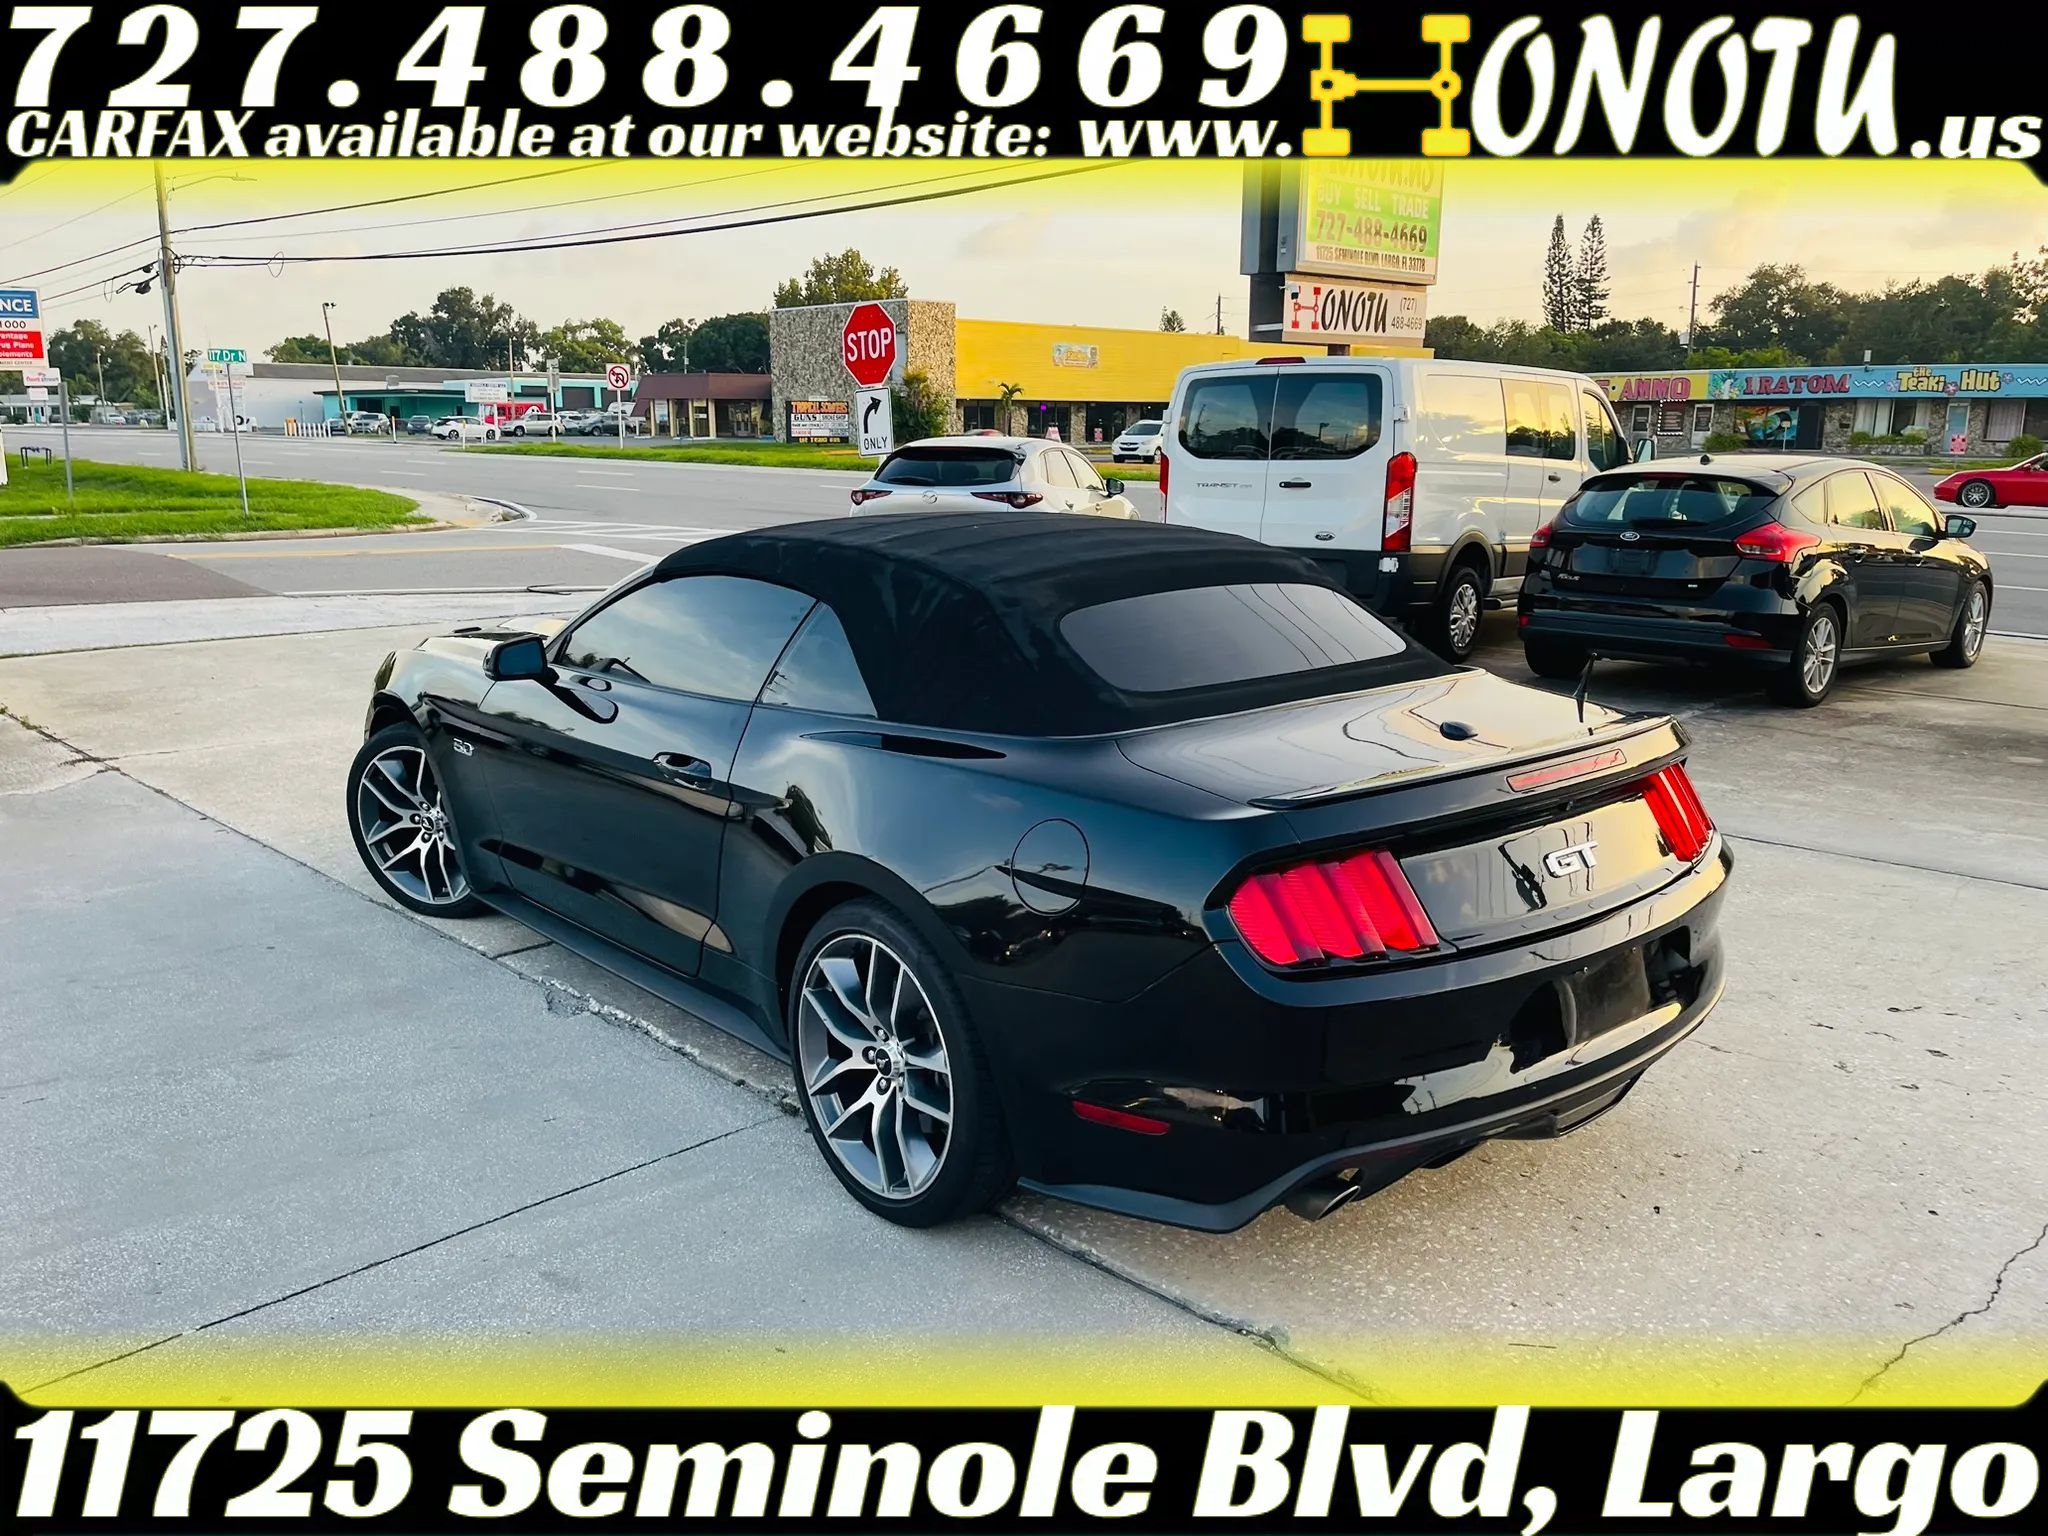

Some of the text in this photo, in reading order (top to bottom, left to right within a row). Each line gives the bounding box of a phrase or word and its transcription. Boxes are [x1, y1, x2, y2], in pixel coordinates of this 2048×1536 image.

[1316, 183, 1429, 219] BUY SELL TRADE
[1316, 209, 1428, 253] 727-488-4669
[1400, 296, 1418, 313] (727)
[1391, 316, 1423, 330] 488-4669
[223, 350, 236, 361] Dr
[238, 351, 247, 362] N
[847, 327, 892, 362] STOP
[1620, 377, 1692, 400] AMMO
[863, 435, 888, 451] ONLY
[1543, 840, 1598, 878] GT
